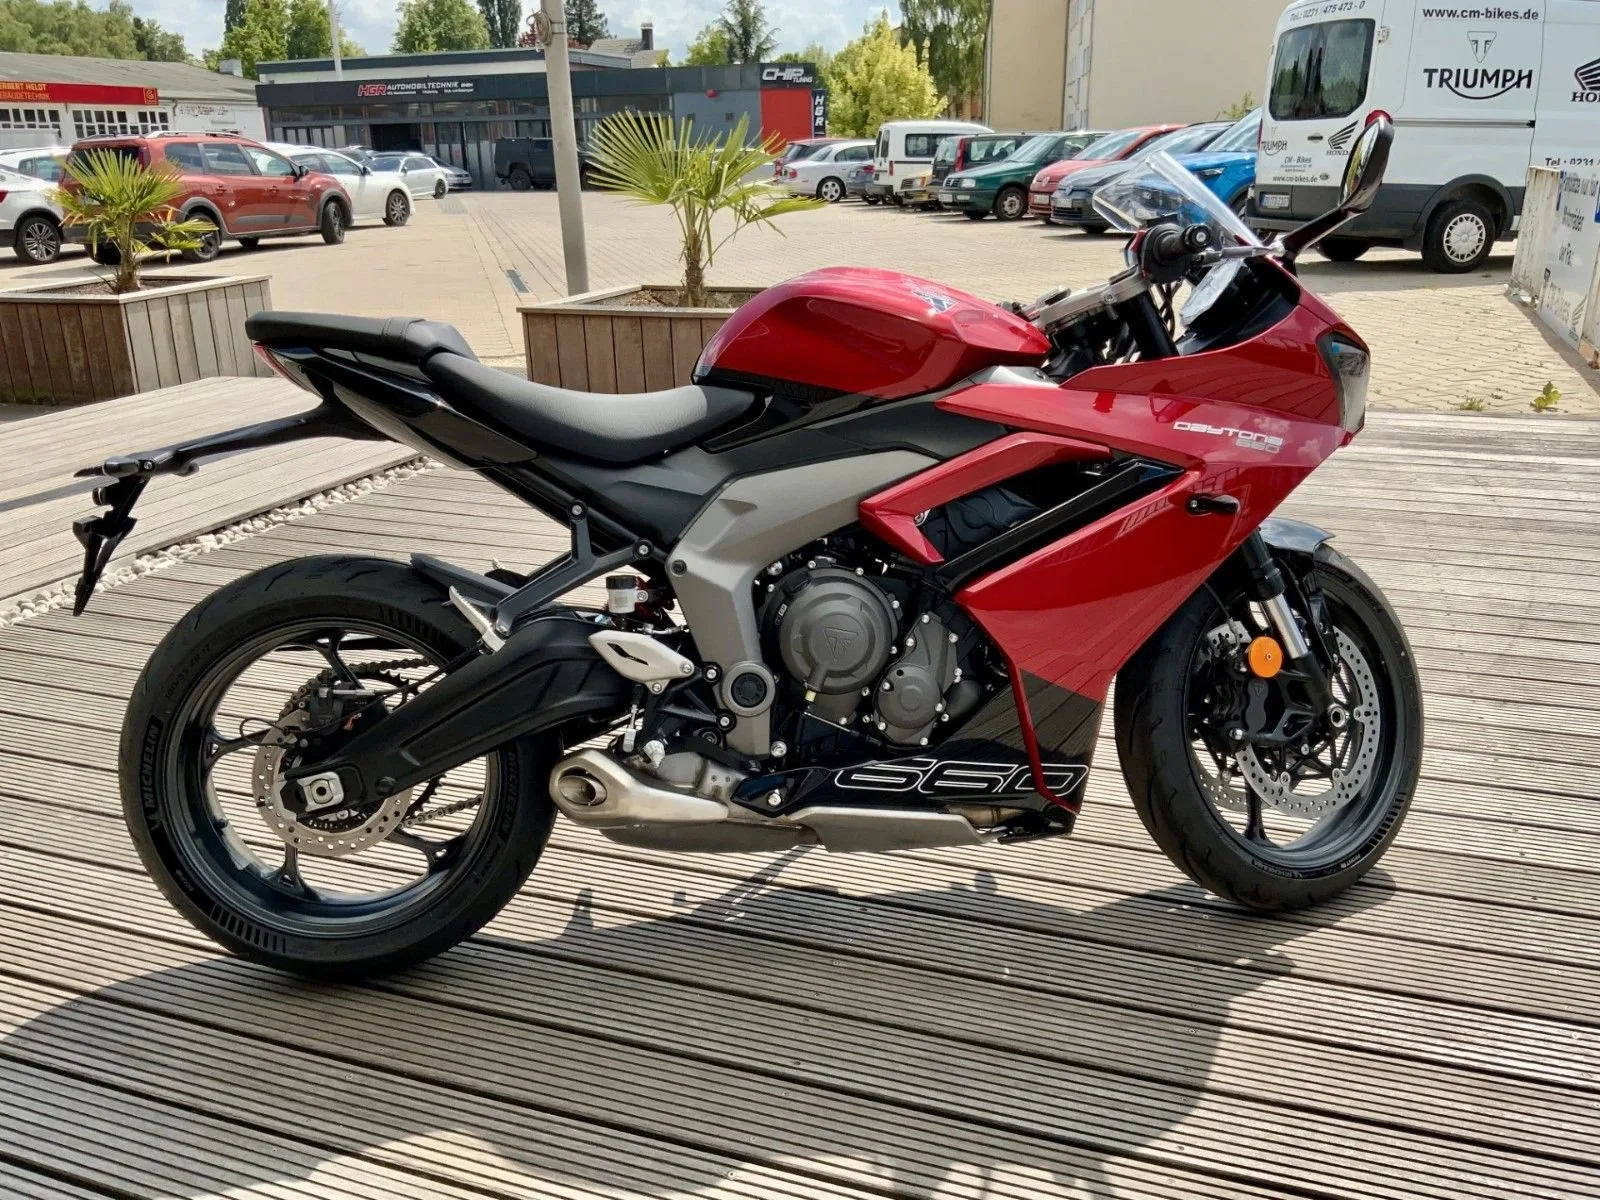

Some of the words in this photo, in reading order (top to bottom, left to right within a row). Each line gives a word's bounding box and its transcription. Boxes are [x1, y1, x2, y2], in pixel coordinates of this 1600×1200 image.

[1323, 4, 1337, 13] 475
[1338, 2, 1353, 11] 473
[1359, 1, 1366, 9] 0
[1423, 7, 1539, 20] www.cm-bikes.de
[762, 68, 804, 81] CHIP
[357, 84, 387, 97] HGR
[387, 81, 459, 91] AUTOMOBILTECHNIK
[1423, 68, 1534, 98] TRIUMPH
[1571, 91, 1600, 103] HO
[814, 95, 825, 127] HGR
[1273, 174, 1318, 183] www.cm-bikes.de
[1235, 438, 1280, 454] 660
[142, 726, 160, 808] MICHELIN
[834, 757, 1089, 798] 660
